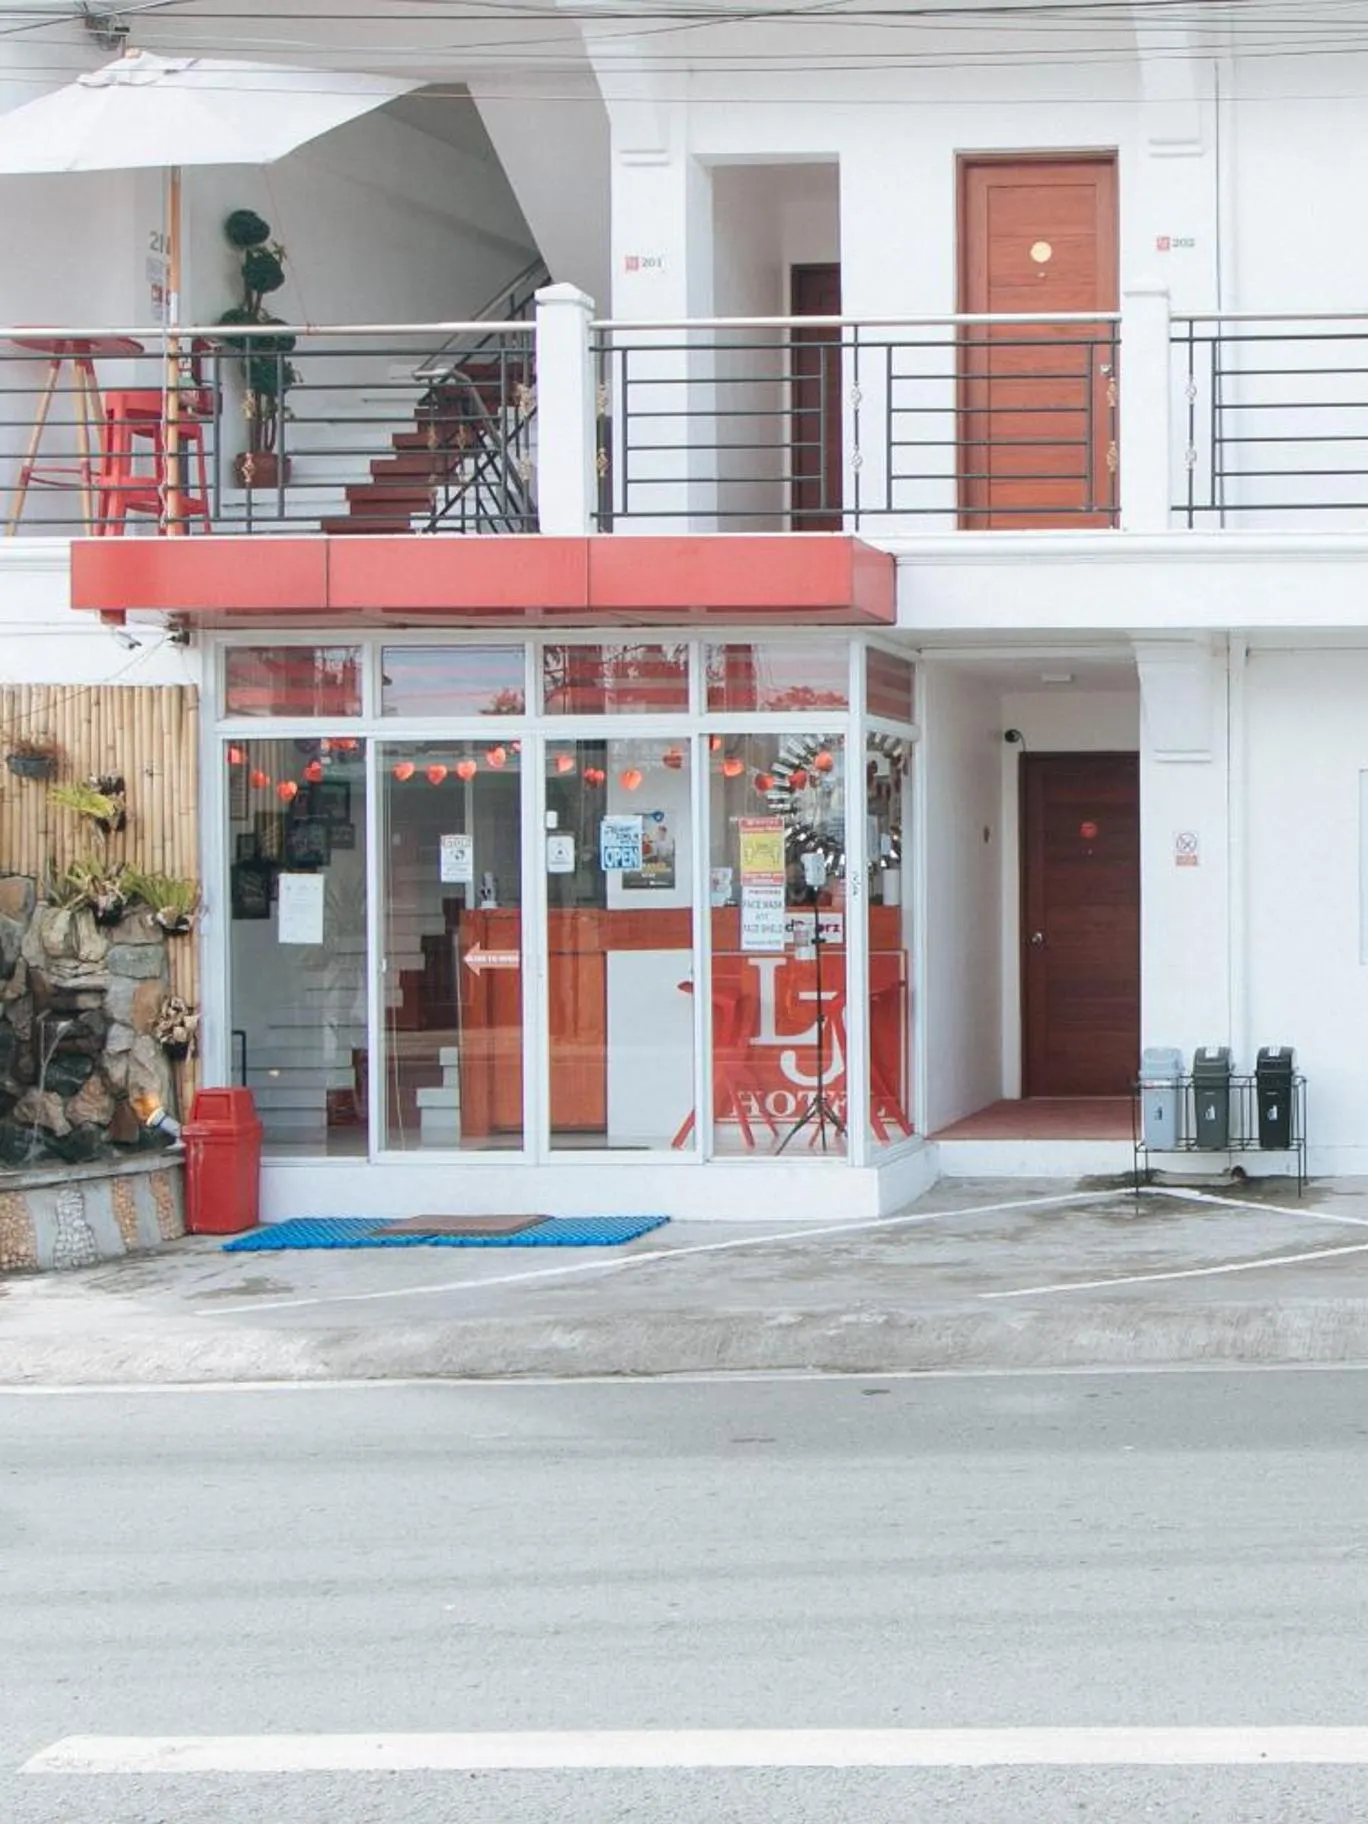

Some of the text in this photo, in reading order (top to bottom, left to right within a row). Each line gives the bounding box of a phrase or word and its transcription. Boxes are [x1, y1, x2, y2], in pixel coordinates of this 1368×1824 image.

[1172, 237, 1196, 248] 202
[642, 257, 662, 268] 201
[605, 847, 640, 868] OPEN
